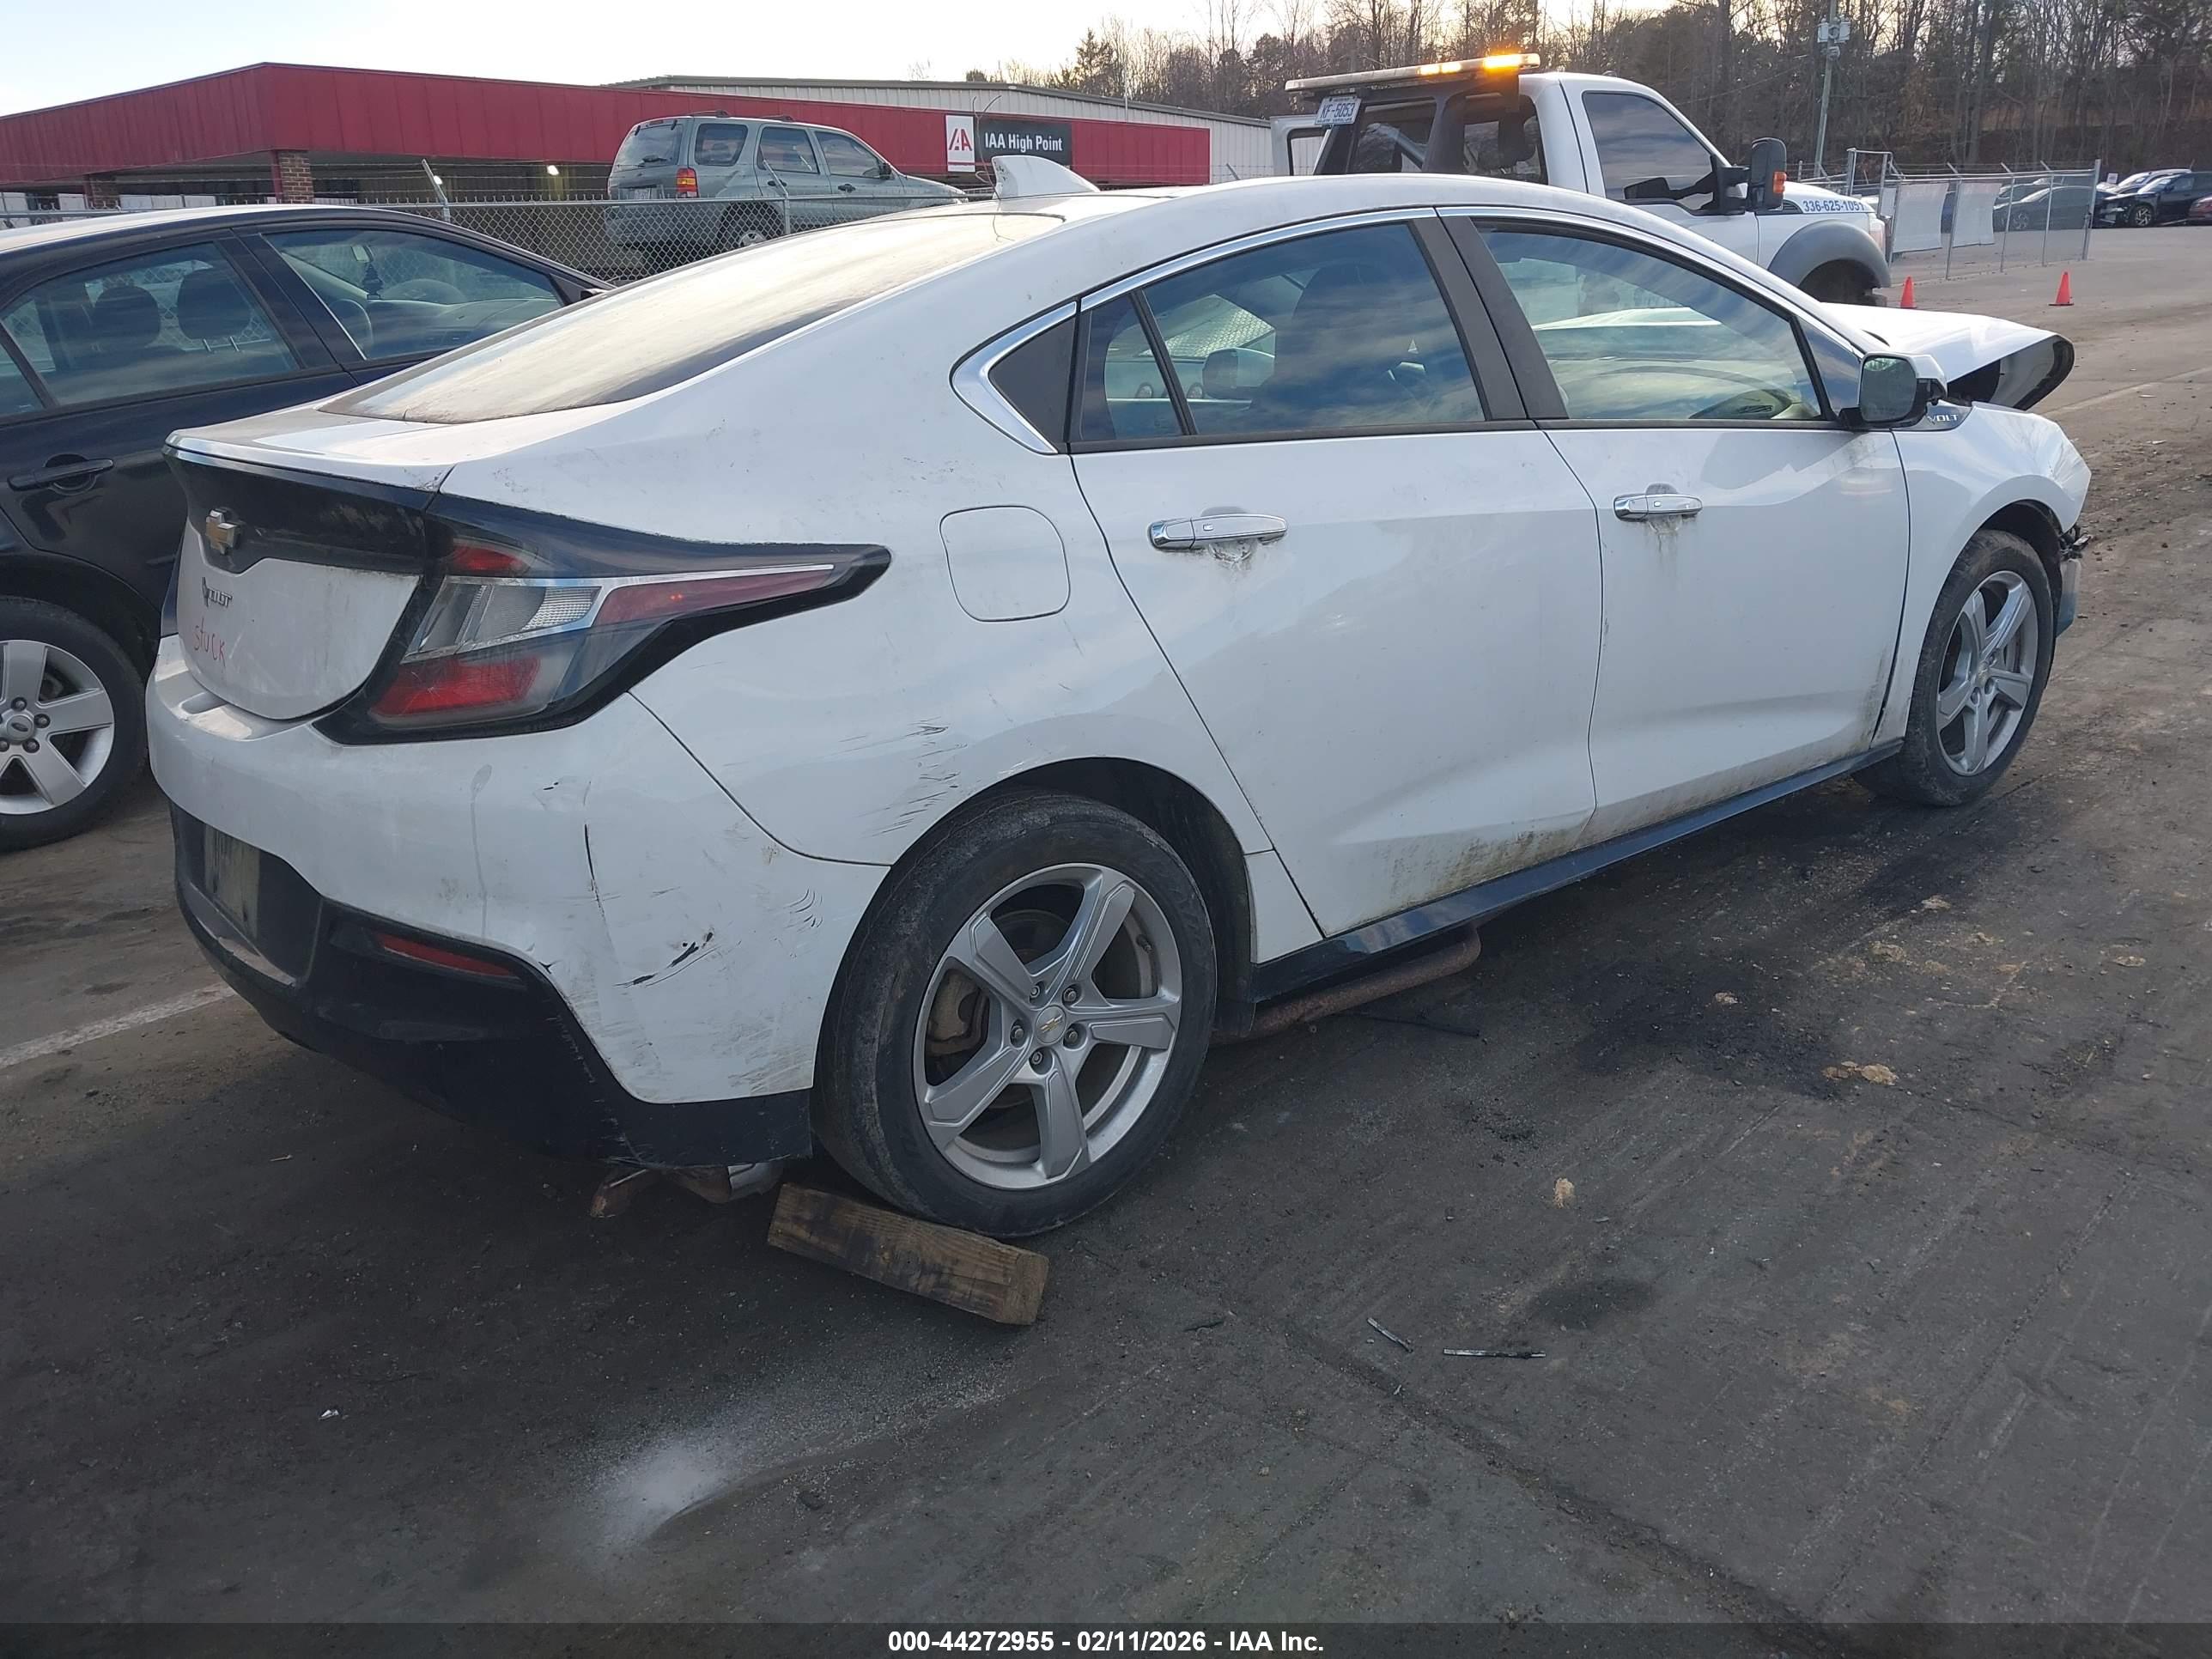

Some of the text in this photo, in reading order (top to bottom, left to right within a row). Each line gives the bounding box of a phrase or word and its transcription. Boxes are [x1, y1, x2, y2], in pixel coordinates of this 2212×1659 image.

[985, 132, 1063, 153] IAA High Point
[1927, 414, 1959, 425] VOLT
